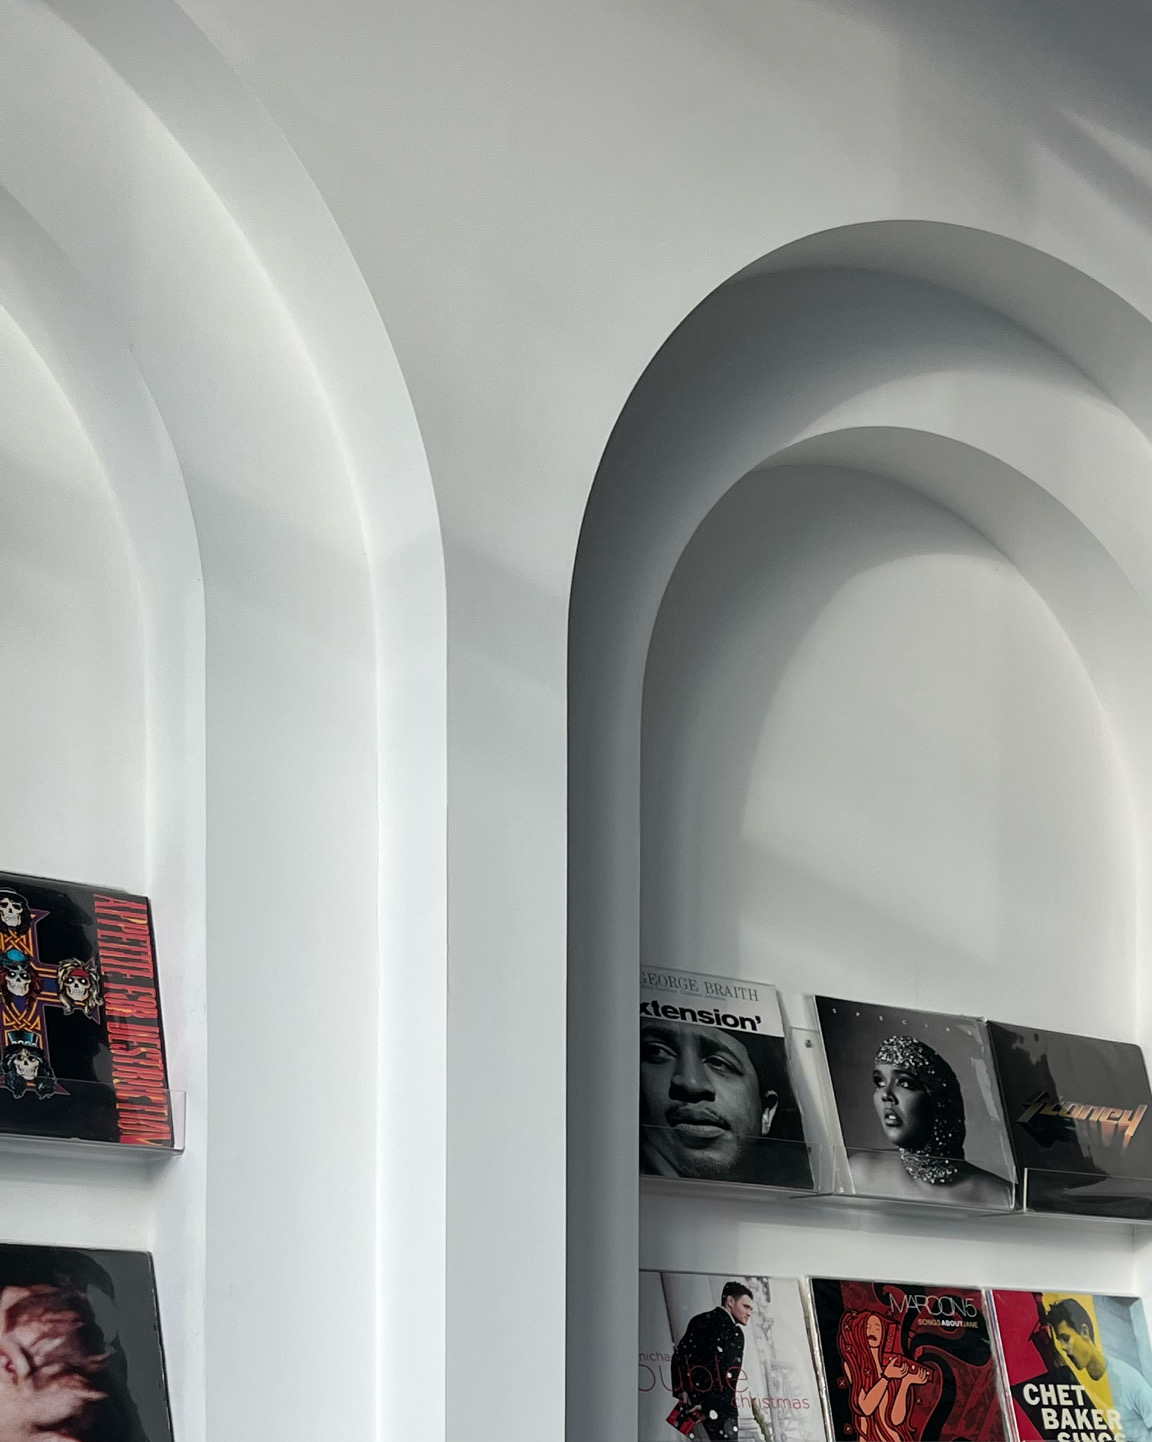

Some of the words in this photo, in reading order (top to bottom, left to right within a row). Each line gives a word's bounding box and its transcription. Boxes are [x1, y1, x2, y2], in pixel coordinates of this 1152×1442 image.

[103, 981, 158, 1019] FOR
[704, 980, 759, 1001] BRAITH
[640, 1000, 761, 1031] xtension'
[731, 1393, 810, 1410] christmas
[1023, 1383, 1085, 1406] CHET
[1041, 1408, 1123, 1430] BAKER
